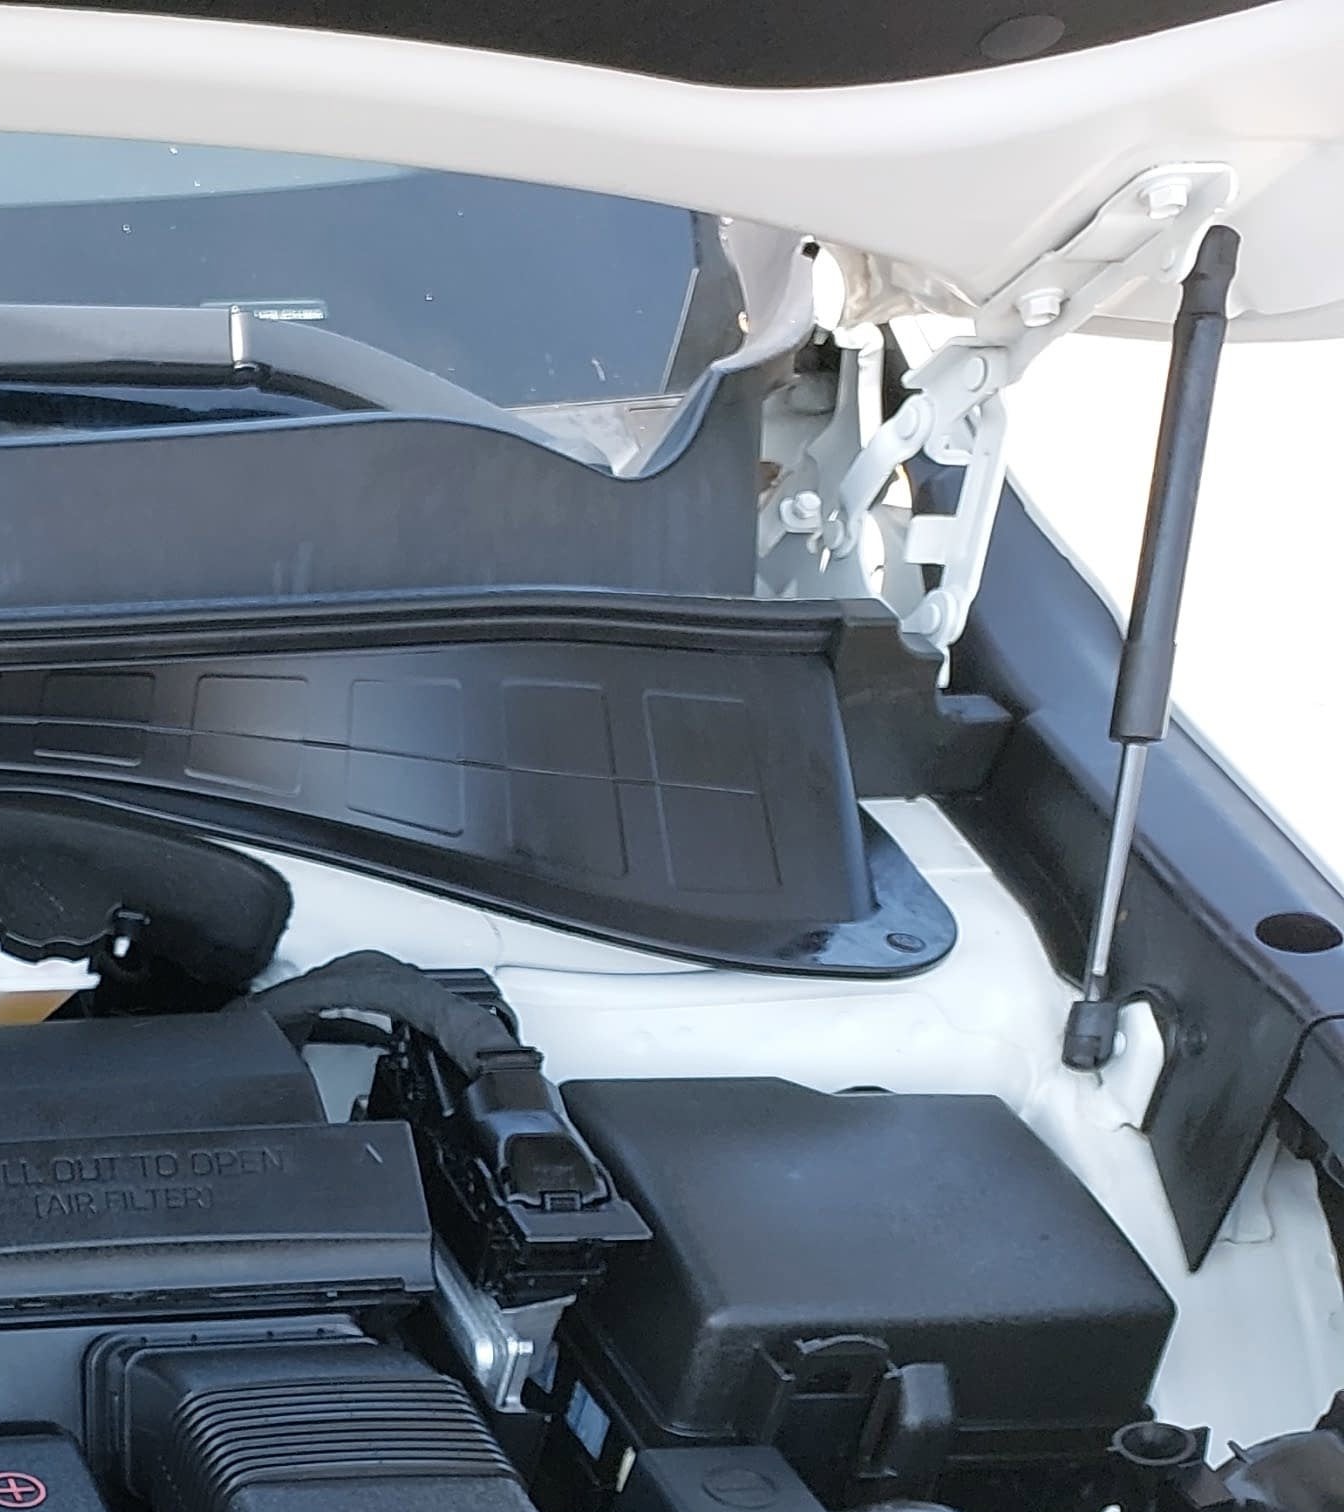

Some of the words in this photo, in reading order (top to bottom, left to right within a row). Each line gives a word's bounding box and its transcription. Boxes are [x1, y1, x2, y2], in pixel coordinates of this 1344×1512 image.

[53, 1154, 120, 1183] OUT
[130, 1152, 179, 1178] TO
[191, 1147, 285, 1176] OPEN
